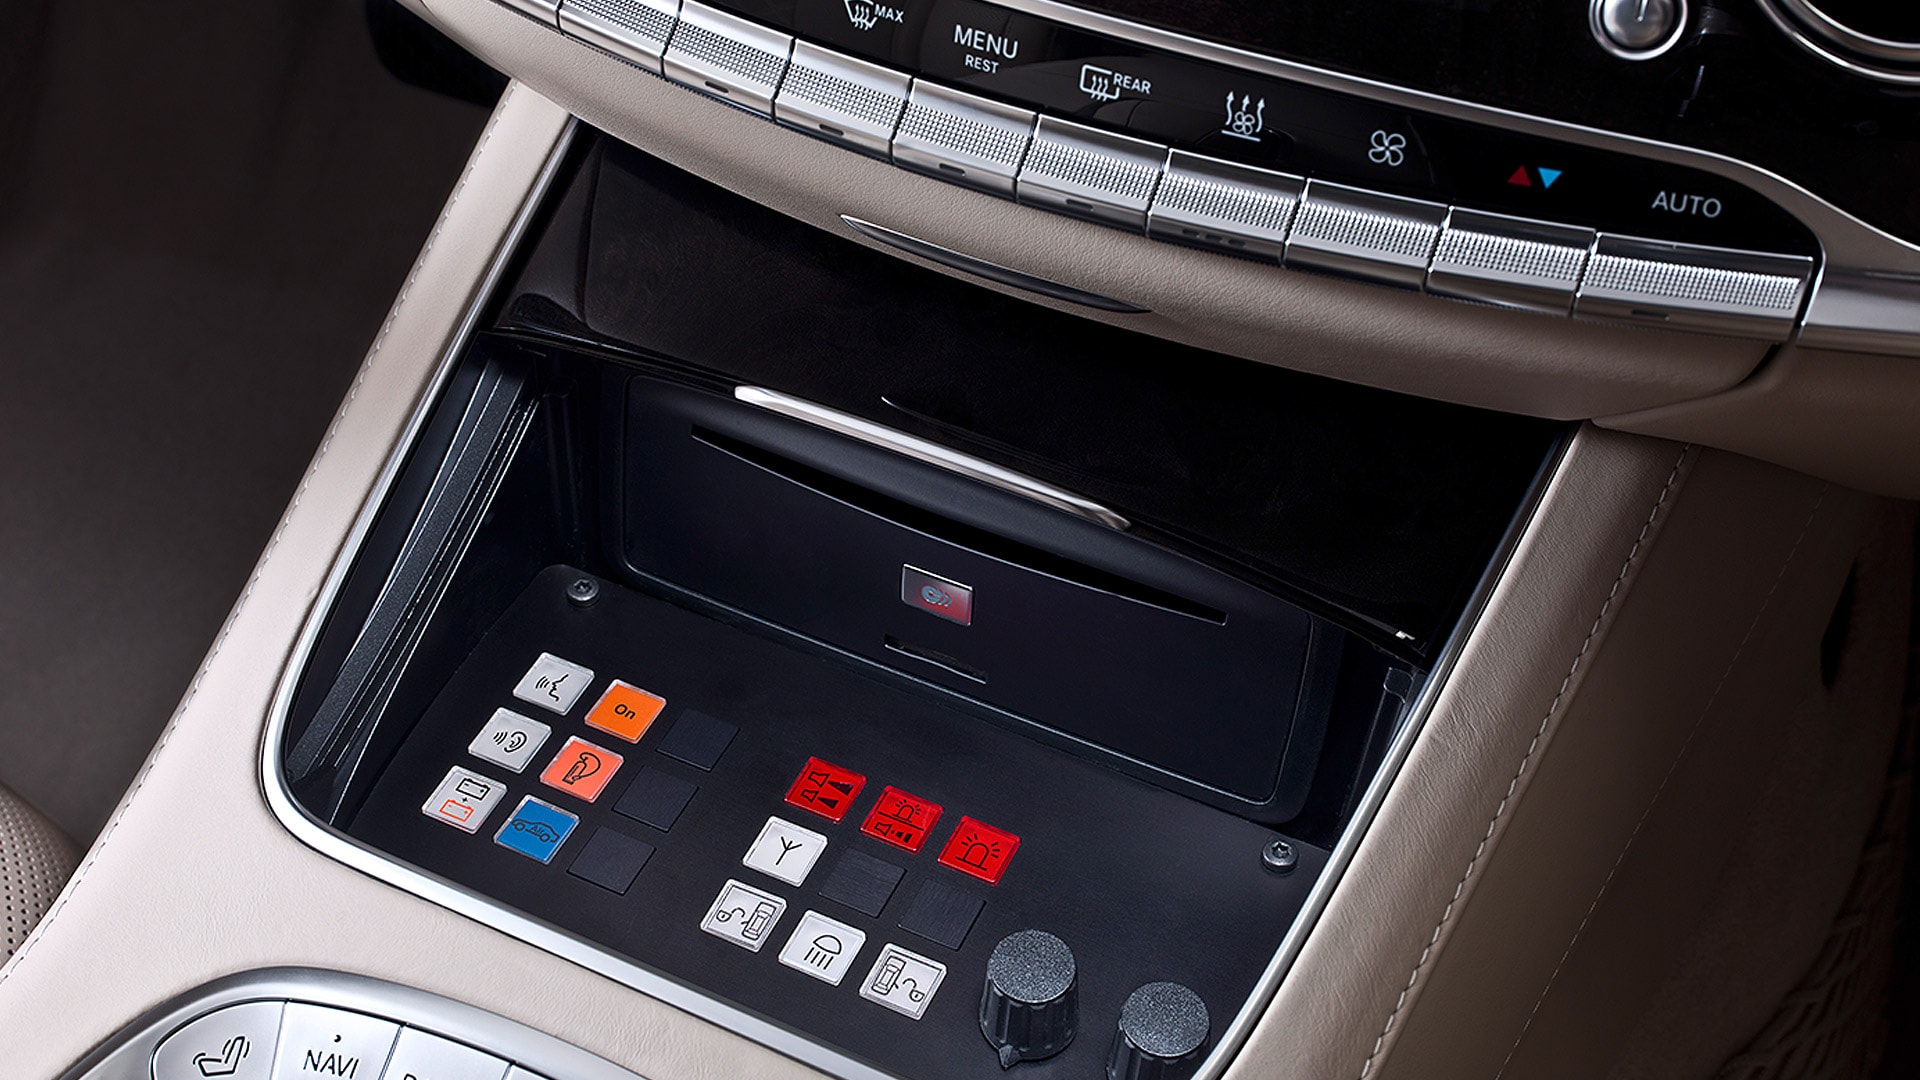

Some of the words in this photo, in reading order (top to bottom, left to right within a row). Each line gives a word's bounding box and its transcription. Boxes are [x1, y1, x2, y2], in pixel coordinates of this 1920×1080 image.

[874, 4, 904, 23] MAX
[954, 24, 1019, 59] MENU
[965, 54, 999, 74] REST
[1113, 73, 1151, 95] REAR
[1651, 190, 1722, 218] AUTO
[614, 704, 636, 719] On
[303, 1049, 360, 1079] NAVI
